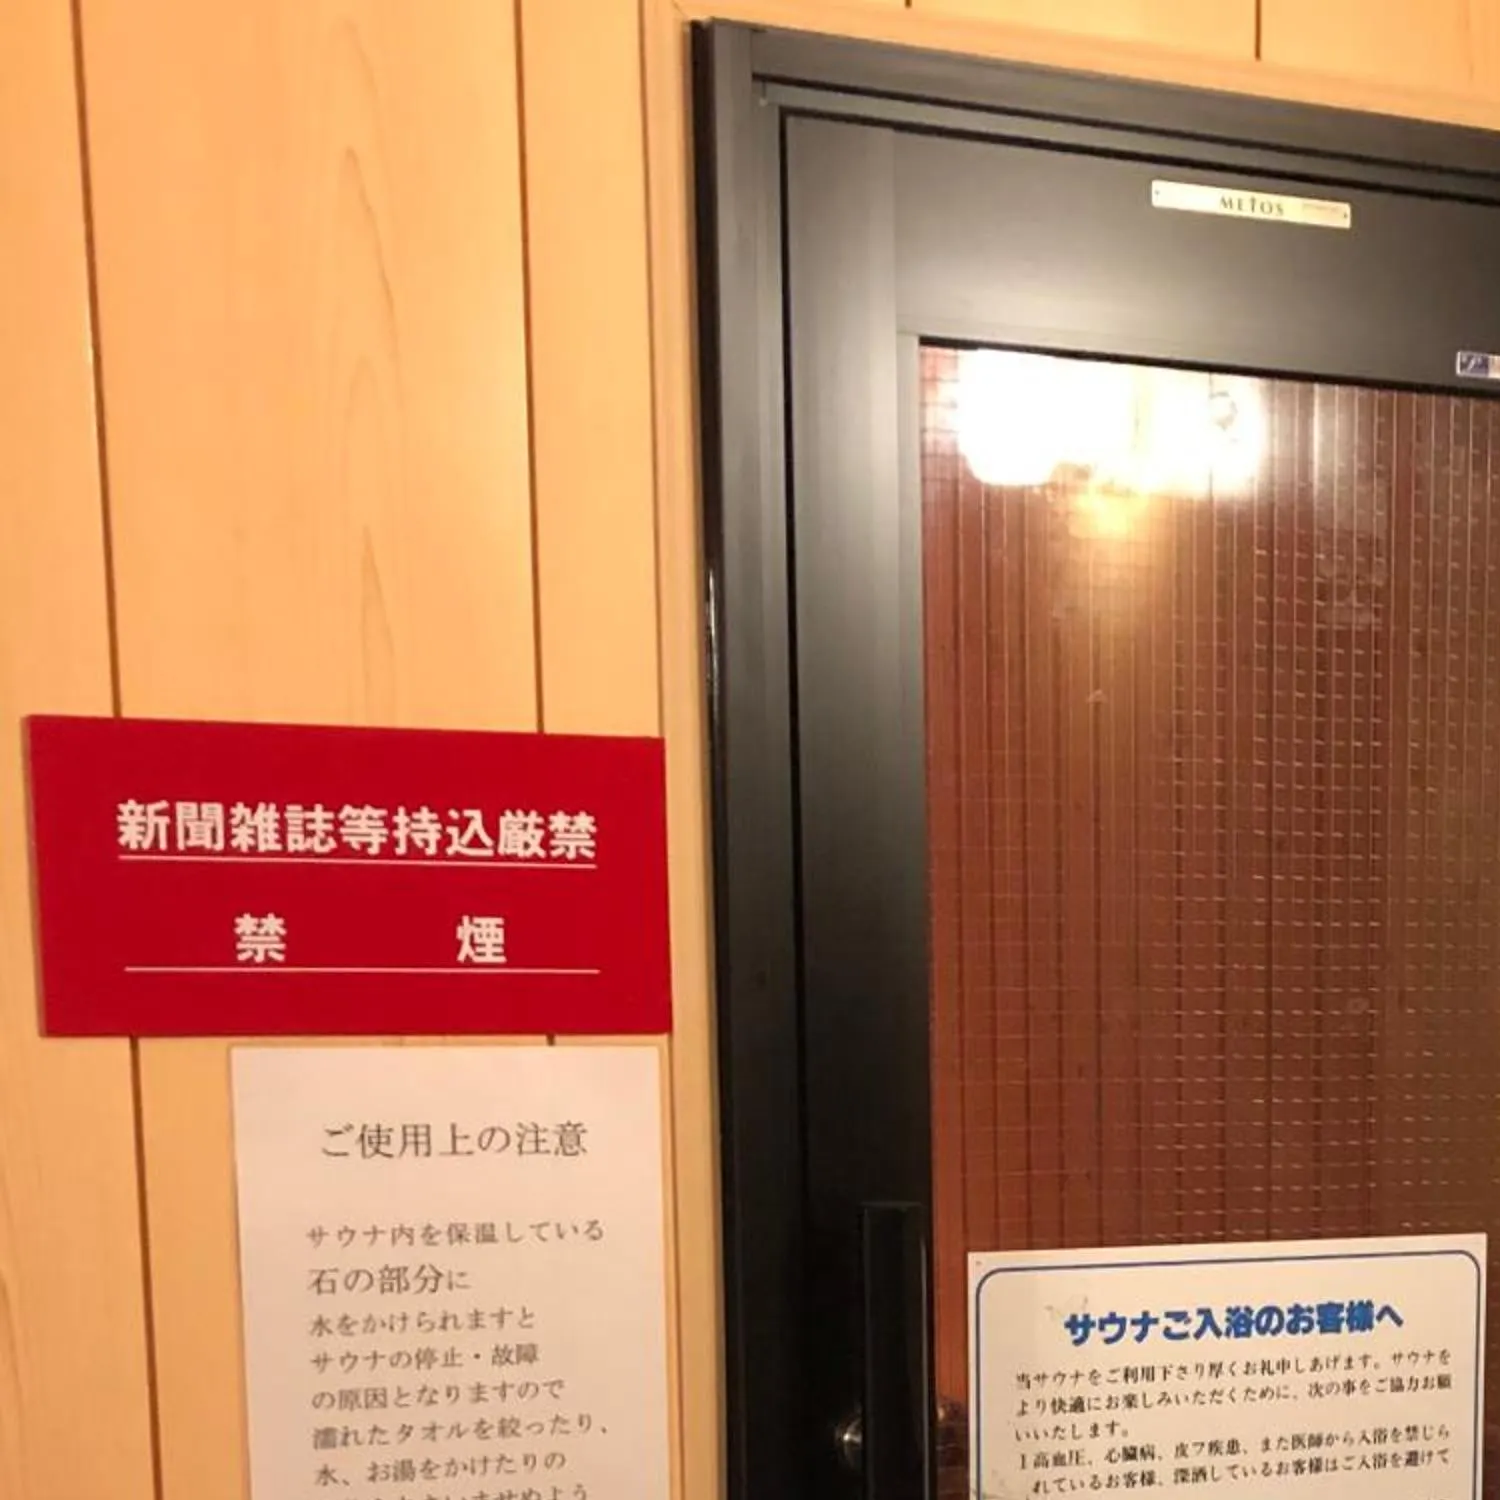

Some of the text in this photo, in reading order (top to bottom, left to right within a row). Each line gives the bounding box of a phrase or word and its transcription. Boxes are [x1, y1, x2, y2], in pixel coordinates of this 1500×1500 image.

[116, 799, 597, 860] 新聞雑誌等持込厳禁
[321, 1121, 589, 1160] ご使用上の注意
[306, 1219, 605, 1249] サウナ内を保温している
[308, 1264, 471, 1295] 石の部分に
[309, 1307, 536, 1337] 水をかけられますと
[1064, 1299, 1404, 1346] サウナご入浴のお客様へ
[310, 1343, 539, 1373] サウナの停止・故障
[312, 1378, 566, 1412] の原因となりますので
[1015, 1419, 1129, 1442] いいたします。
